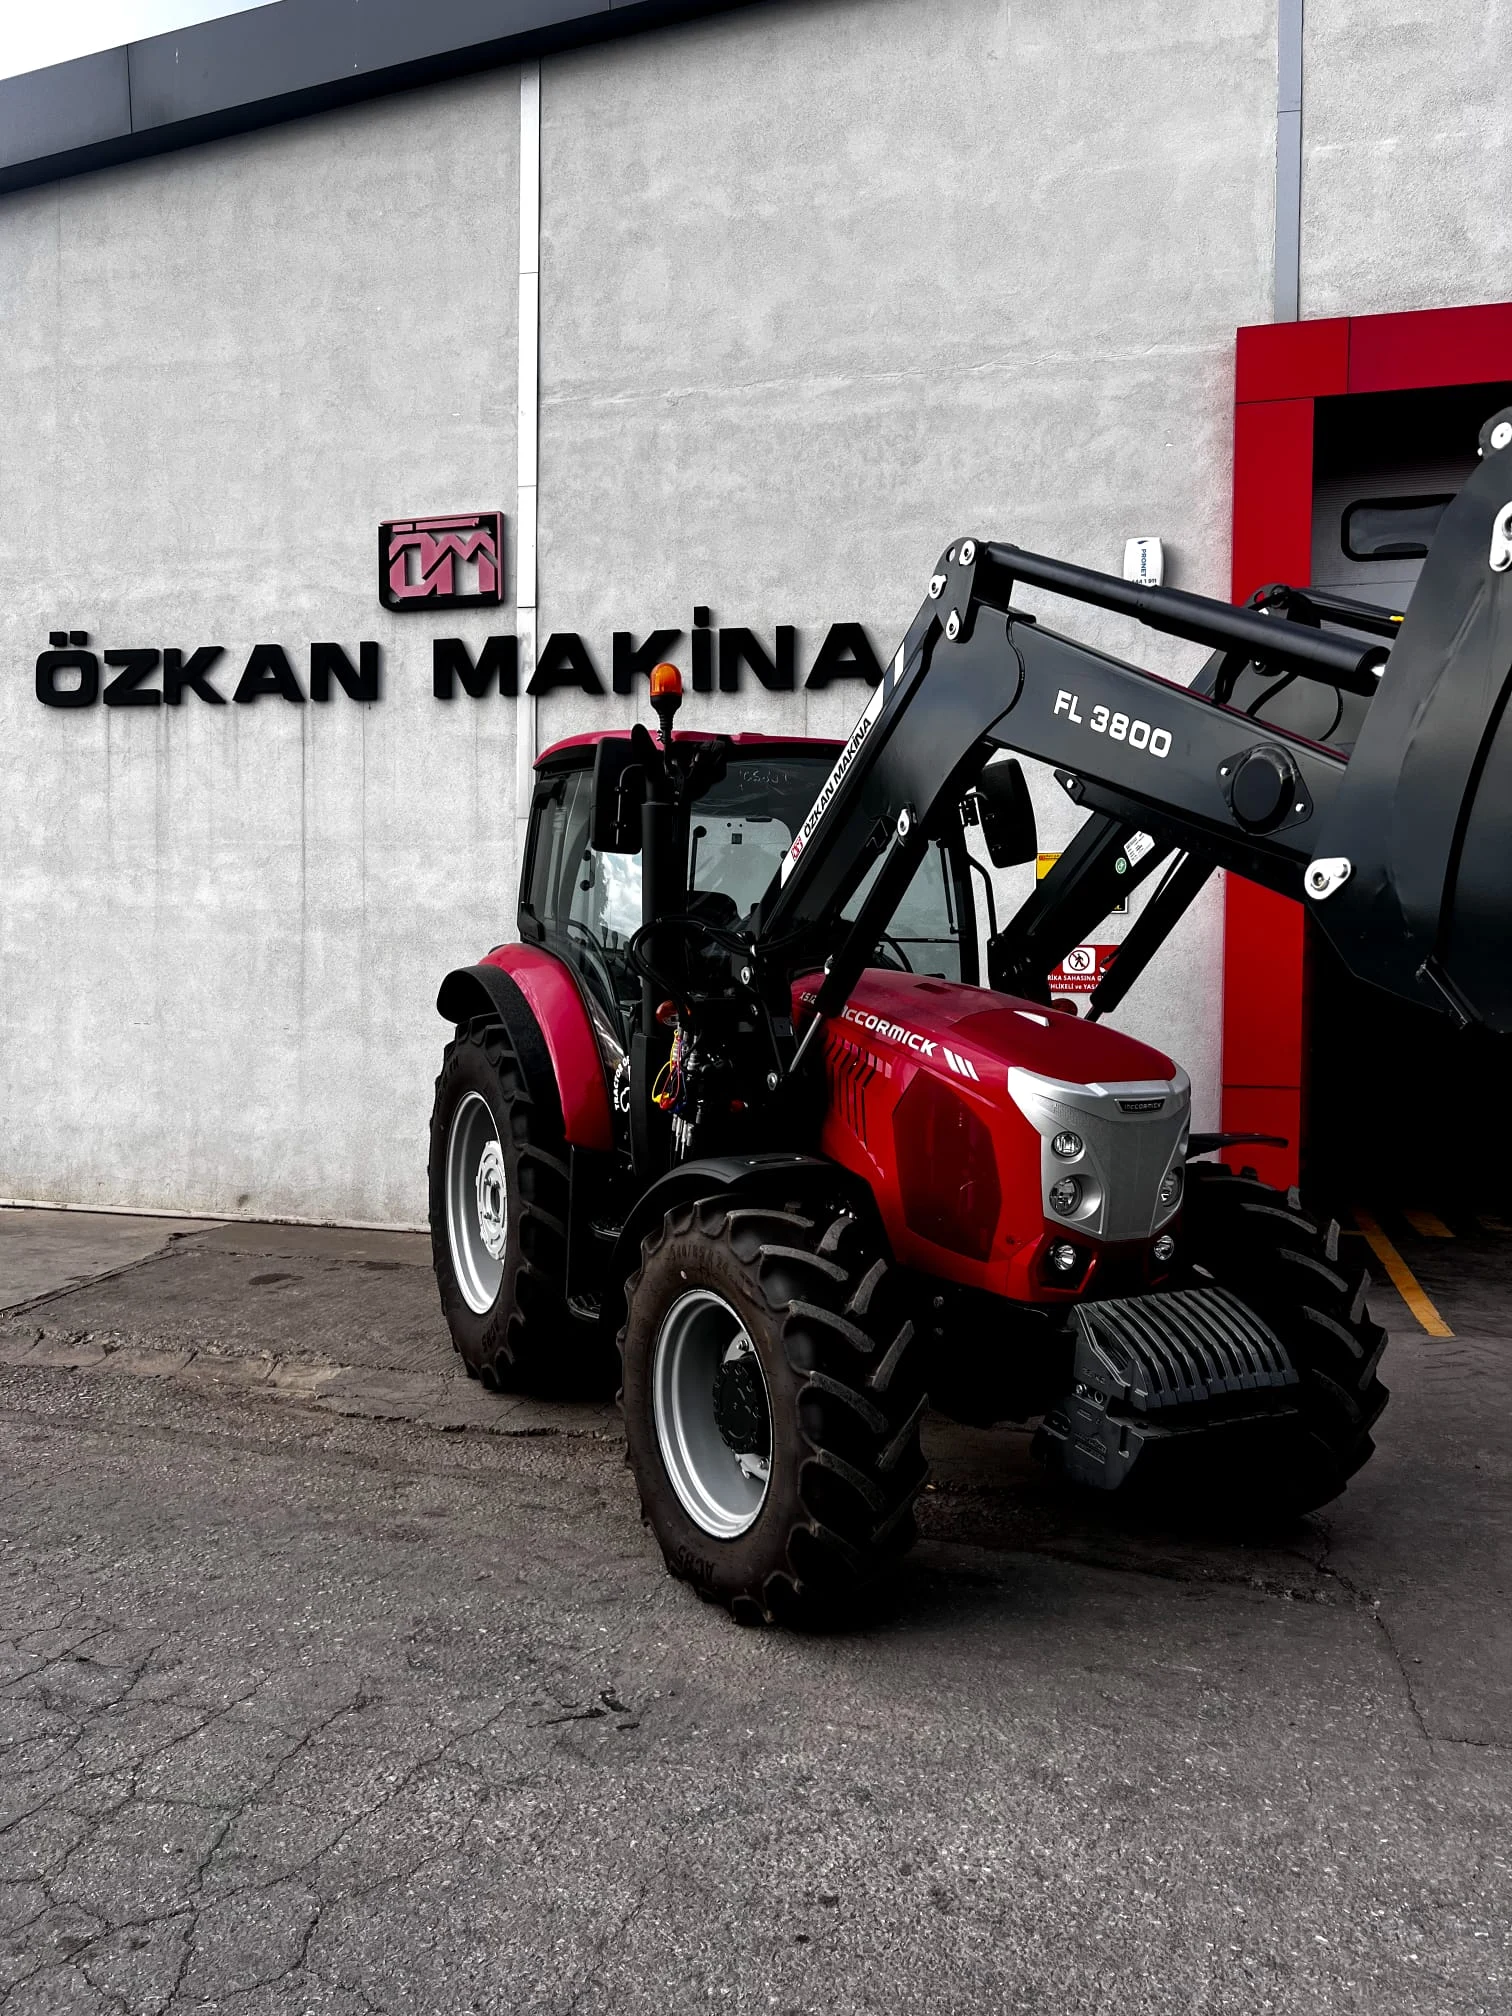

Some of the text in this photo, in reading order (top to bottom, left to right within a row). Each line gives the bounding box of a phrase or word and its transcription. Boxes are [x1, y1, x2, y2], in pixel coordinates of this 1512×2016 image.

[36, 606, 885, 707] ÖZKAN MAKİNA
[1053, 689, 1173, 759] FL 3800
[804, 717, 872, 838] ÖZKAN MAKİNA
